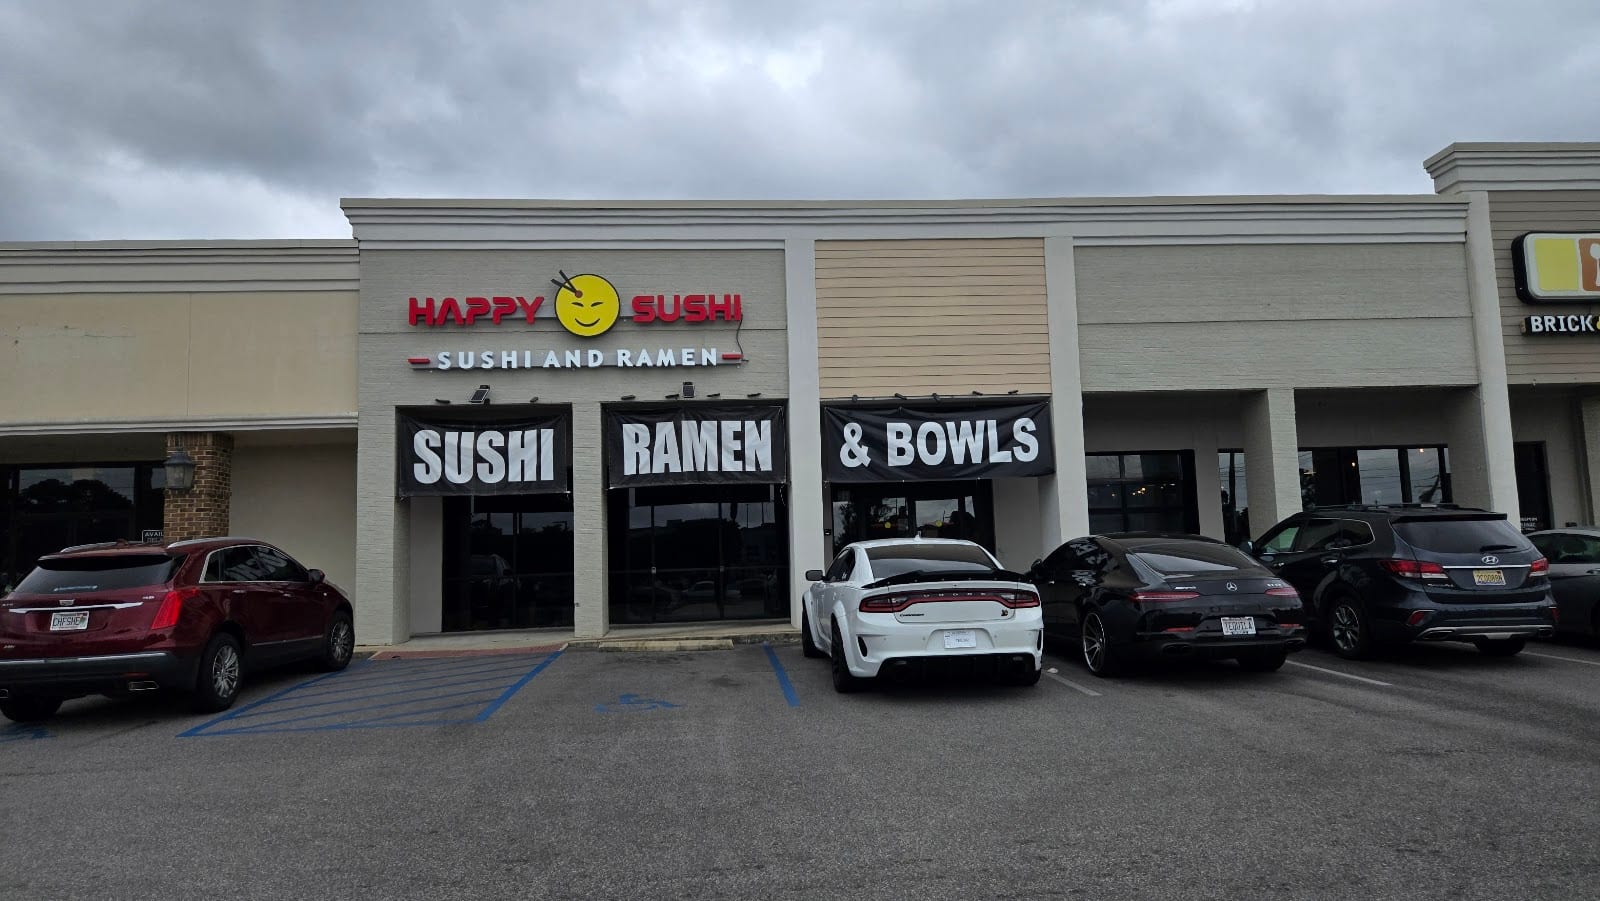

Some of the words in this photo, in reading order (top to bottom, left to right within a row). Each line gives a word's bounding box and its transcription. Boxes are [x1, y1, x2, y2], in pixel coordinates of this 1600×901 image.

[408, 296, 544, 326] HAPPY
[631, 294, 742, 323] SUSHI
[1530, 315, 1595, 332] BRICK
[437, 350, 531, 370] SUSHI
[542, 349, 604, 368] AND
[617, 347, 718, 367] RAMEN
[413, 428, 554, 484] SUSHI
[622, 420, 773, 476] RAMEN
[839, 422, 871, 468] &
[886, 417, 1039, 467] BOWLS
